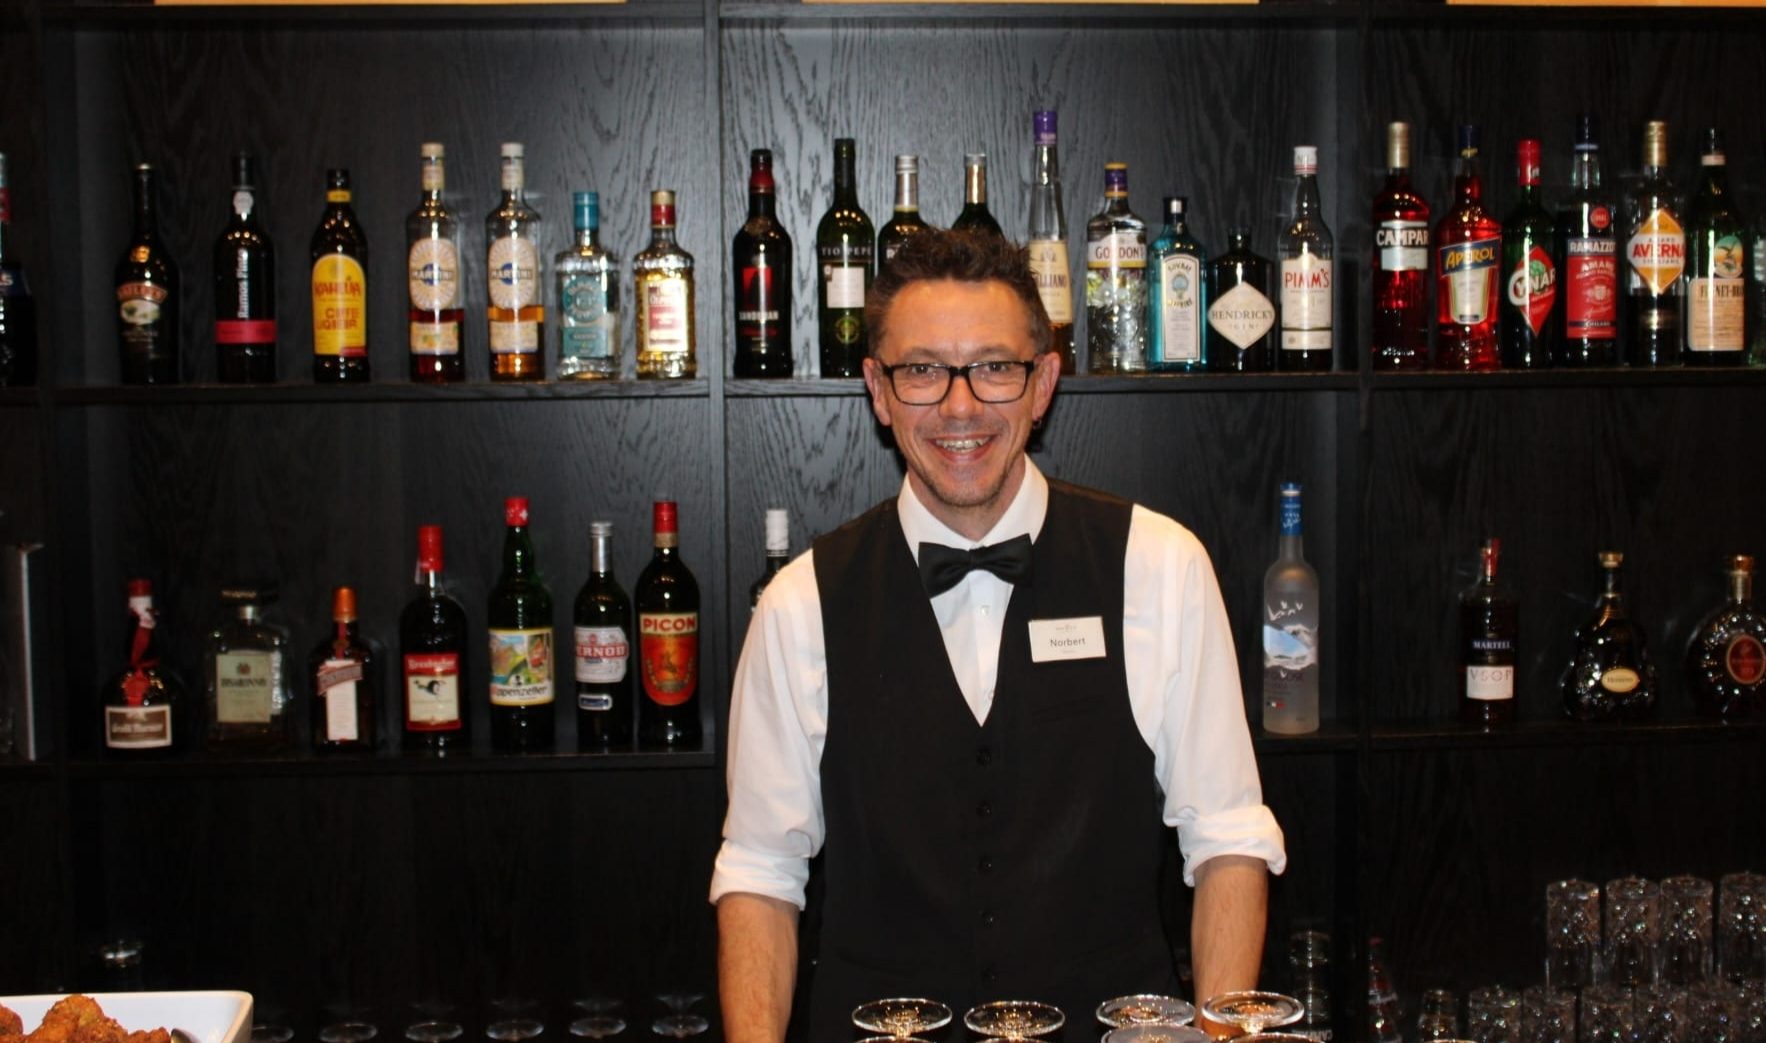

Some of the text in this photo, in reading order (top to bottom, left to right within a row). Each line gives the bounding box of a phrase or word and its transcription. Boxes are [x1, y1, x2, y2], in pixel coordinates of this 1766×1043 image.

[1284, 268, 1330, 289] PIMM'S
[643, 617, 696, 631] PICON
[1050, 638, 1086, 647] Norbert
